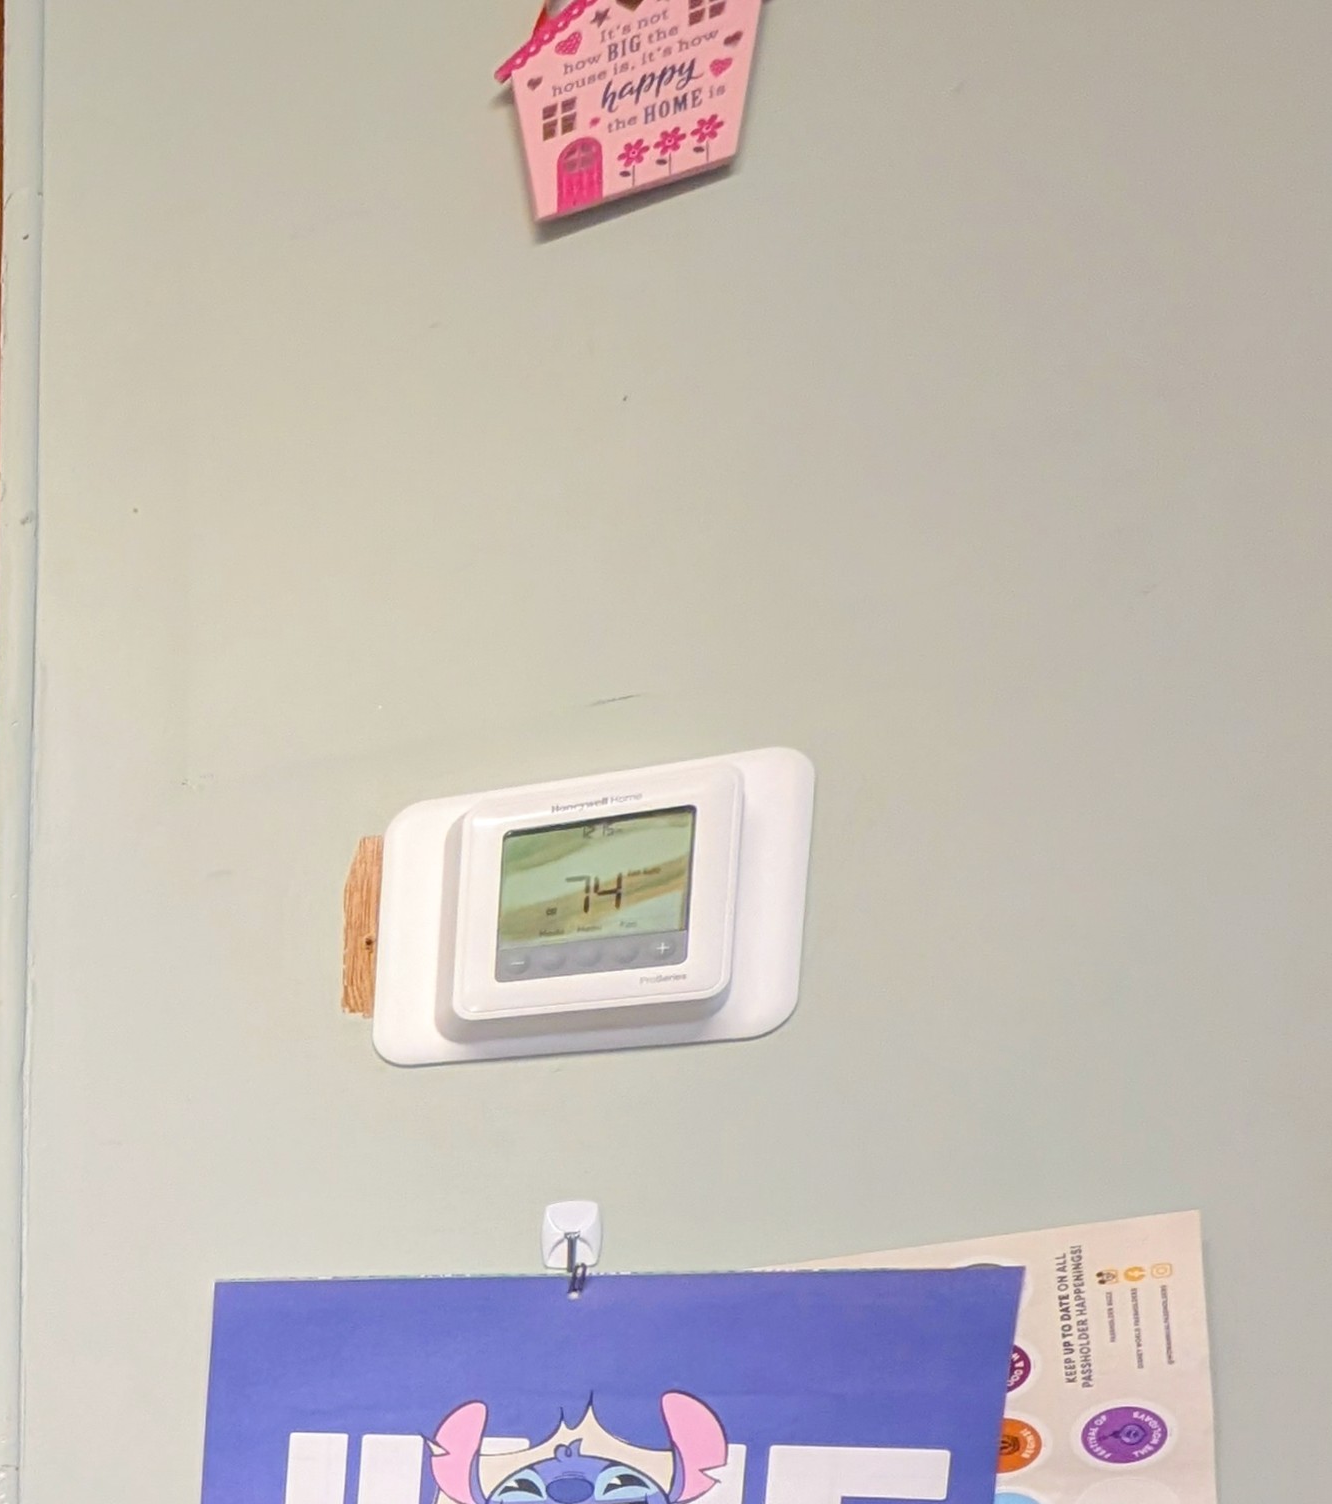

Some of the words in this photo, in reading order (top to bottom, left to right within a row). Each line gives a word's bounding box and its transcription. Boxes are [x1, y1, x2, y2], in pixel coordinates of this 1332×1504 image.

[600, 20, 632, 44] It's
[637, 9, 670, 30] not
[552, 71, 608, 97] house
[641, 45, 674, 66] it's
[677, 29, 719, 50] how
[563, 53, 602, 75] how
[607, 35, 641, 62] BIG
[647, 25, 679, 45] the
[601, 57, 704, 113] happy
[607, 114, 637, 133] the
[643, 86, 703, 125] HOME
[708, 83, 726, 99] is
[550, 796, 608, 813] Honeywell
[565, 871, 623, 914] 74
[639, 974, 687, 985] ProSeries
[1055, 1252, 1067, 1273] ALL
[1056, 1275, 1068, 1292] ON
[1070, 1244, 1087, 1316] HAPPENINGS!
[1058, 1294, 1071, 1321] DATE
[1061, 1324, 1073, 1338] TO
[1062, 1340, 1075, 1355] UP
[1076, 1318, 1094, 1388] PASSHOLDER
[1065, 1357, 1077, 1383] KEEP
